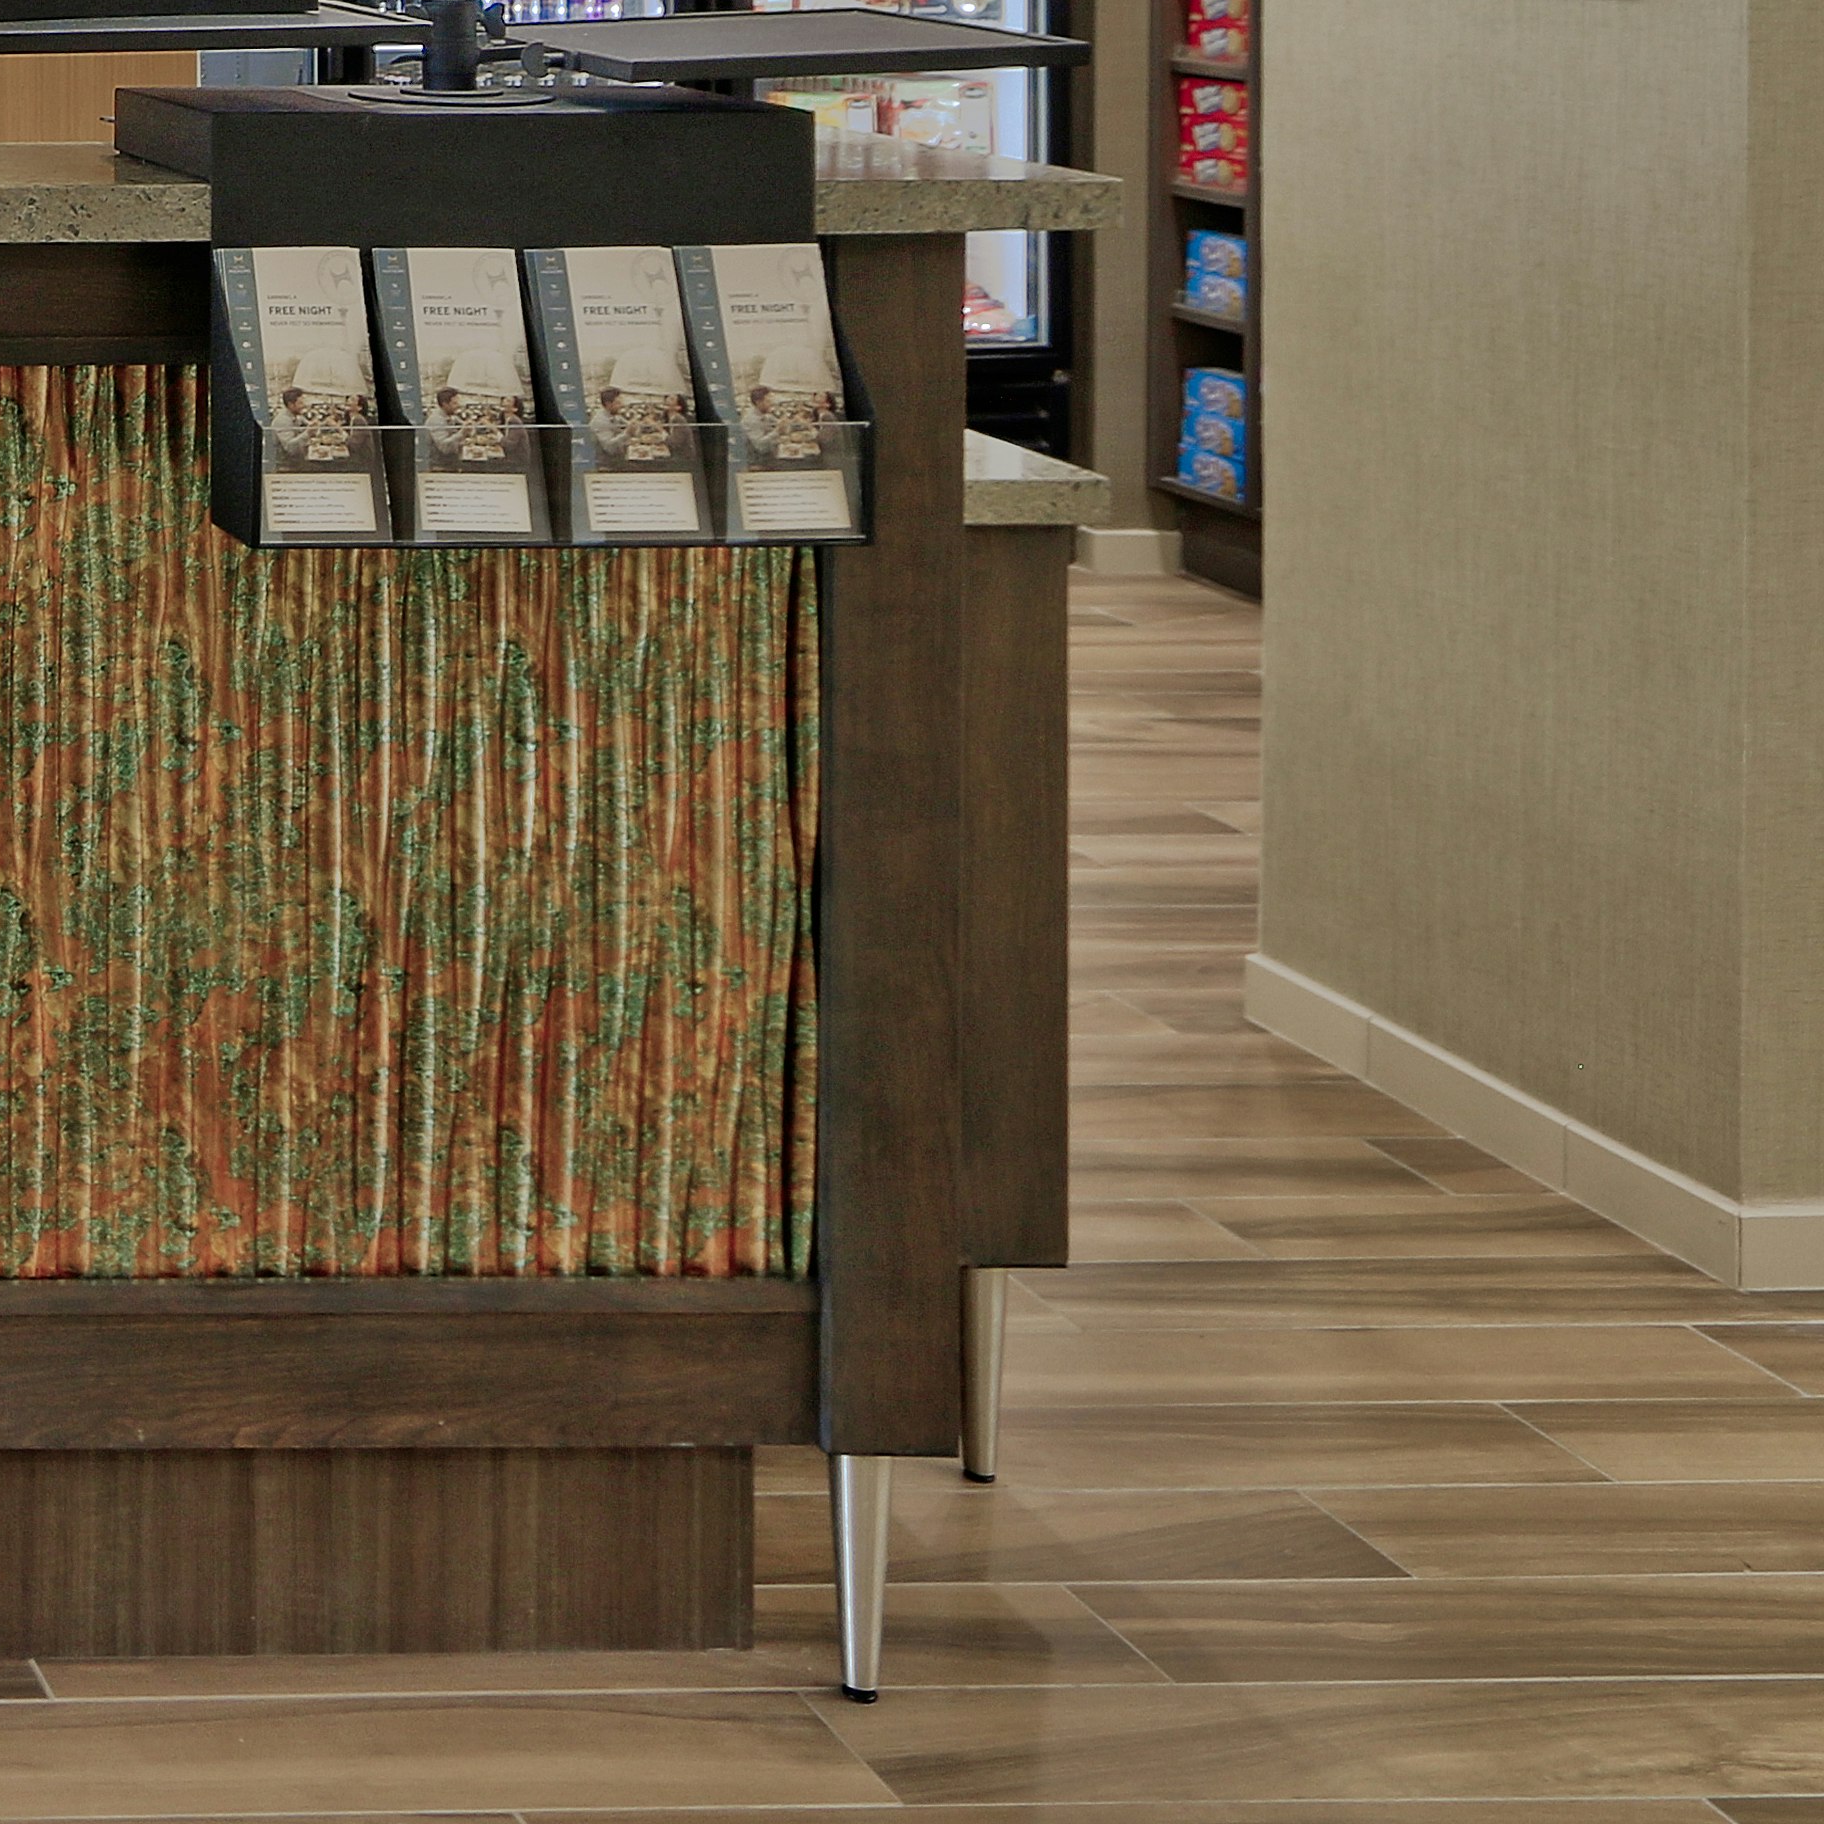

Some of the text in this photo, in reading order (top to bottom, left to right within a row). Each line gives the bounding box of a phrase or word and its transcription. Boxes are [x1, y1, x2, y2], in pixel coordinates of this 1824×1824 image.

[269, 306, 332, 316] FREE NIGHT
[423, 306, 488, 316] FREE NIGHT
[583, 306, 648, 316] FREE NIGHT
